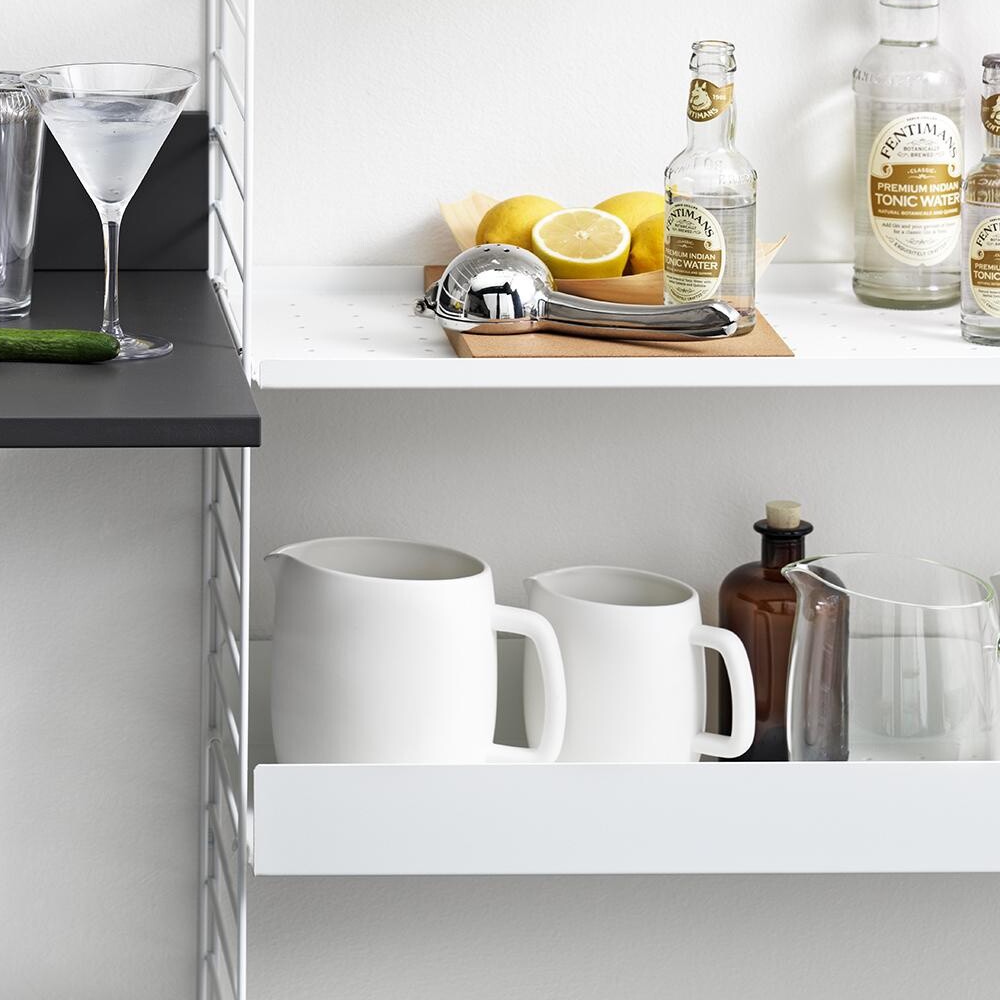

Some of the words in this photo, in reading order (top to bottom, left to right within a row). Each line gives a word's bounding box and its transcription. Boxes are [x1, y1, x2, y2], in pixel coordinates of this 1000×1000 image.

[880, 122, 957, 159] FENTIMANS
[877, 182, 928, 193] PREMIUM
[929, 181, 959, 193] INDIAN
[875, 192, 918, 208] TONIC
[920, 192, 960, 207] WATER
[689, 252, 716, 260] INDIAN
[683, 260, 718, 270] WATER
[973, 270, 1000, 281] TONIC
